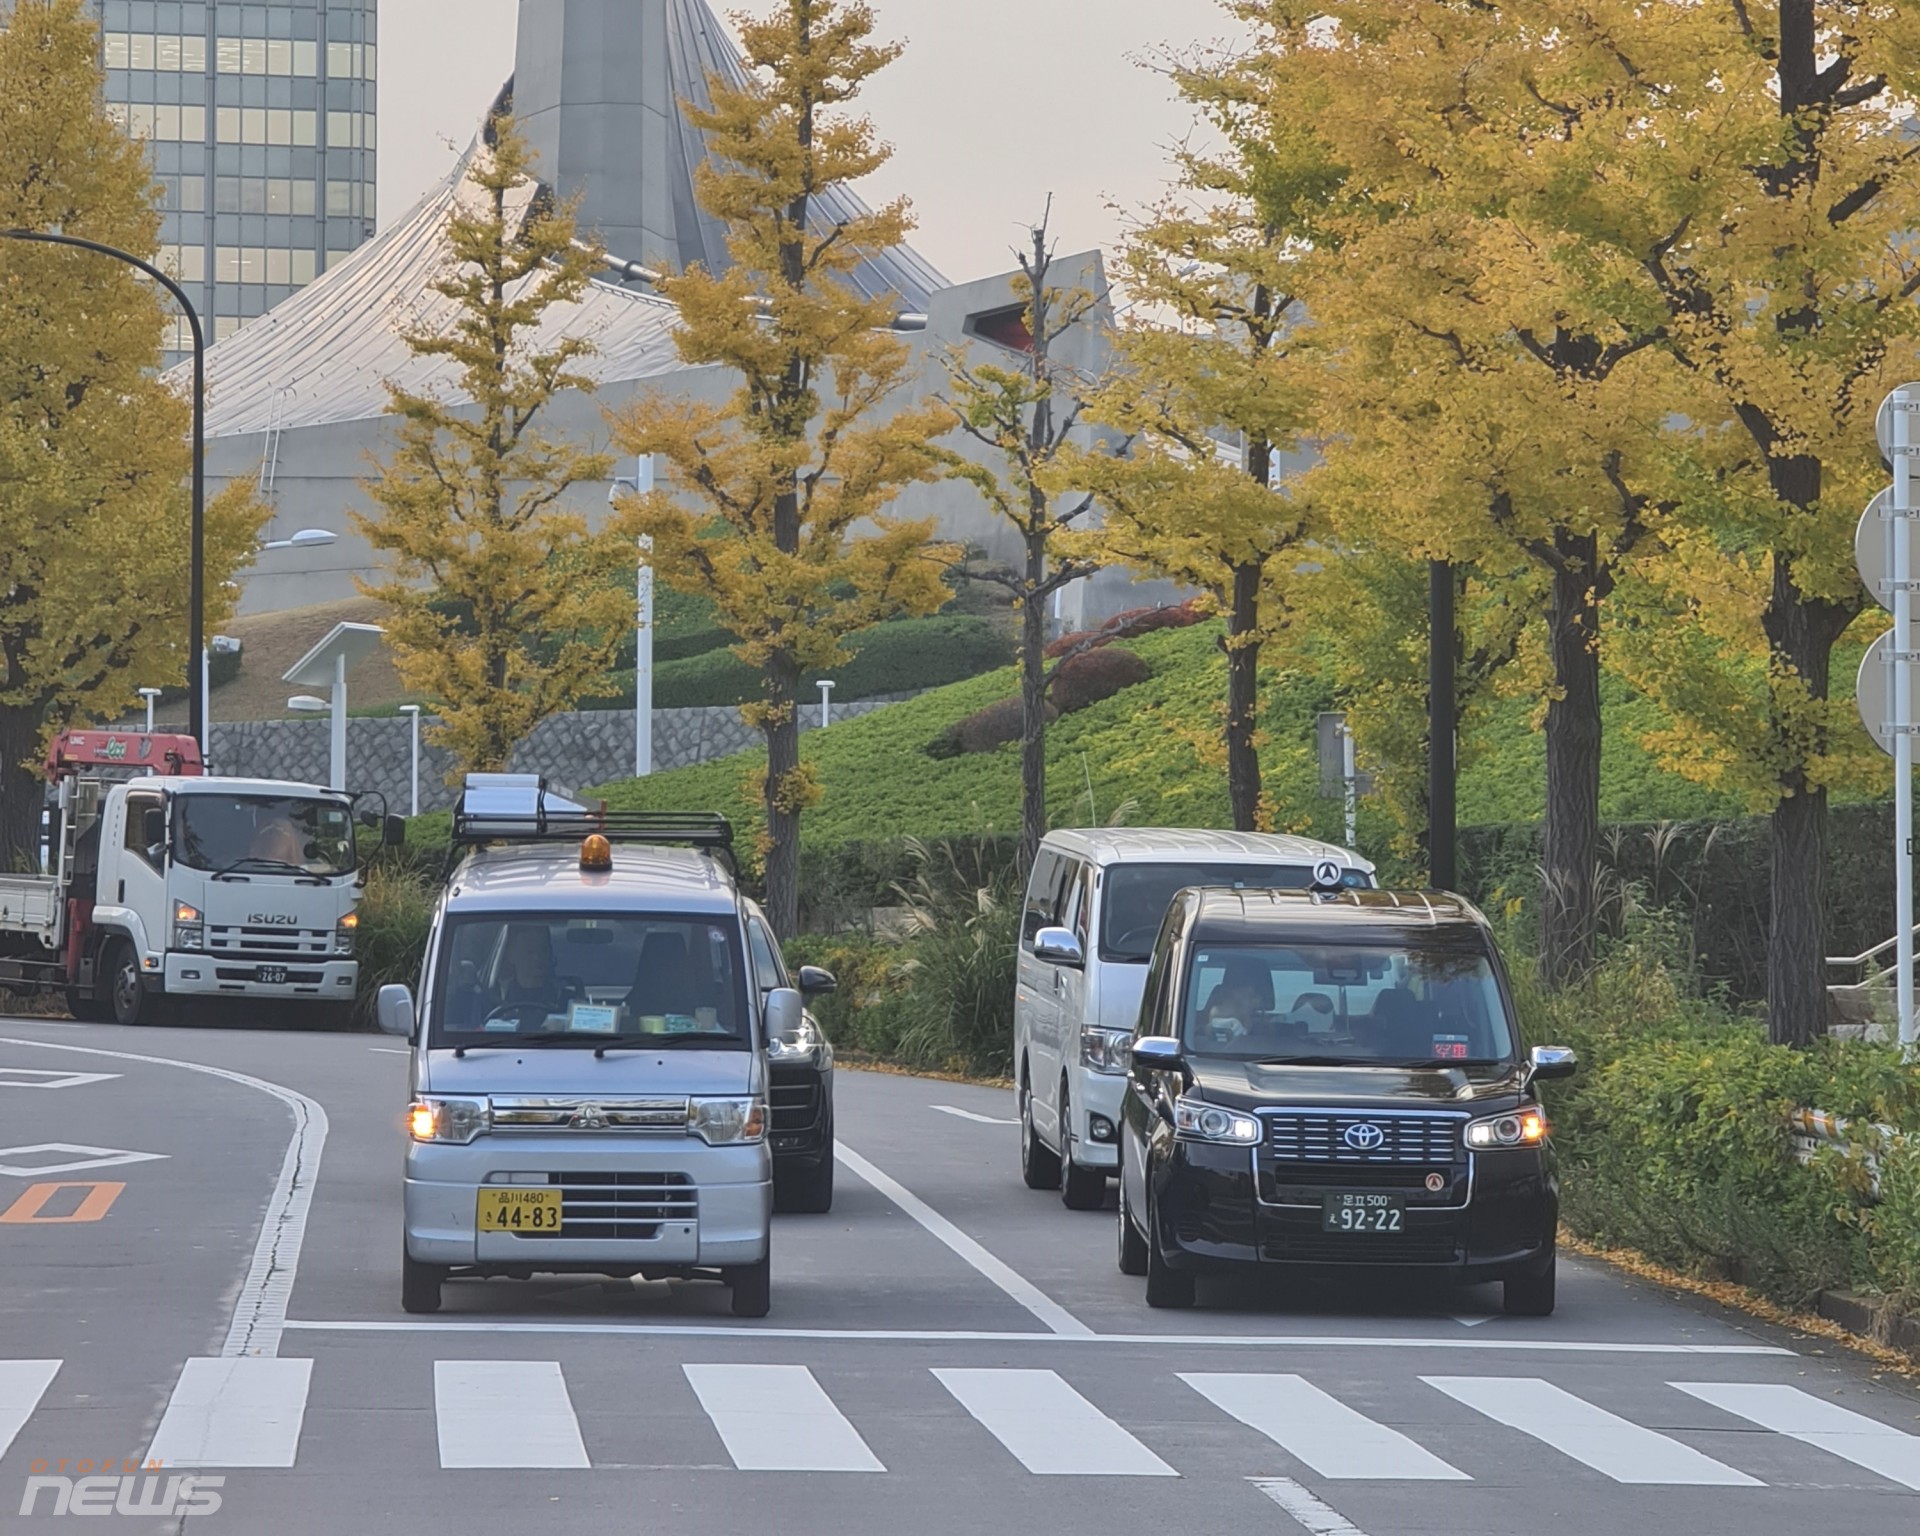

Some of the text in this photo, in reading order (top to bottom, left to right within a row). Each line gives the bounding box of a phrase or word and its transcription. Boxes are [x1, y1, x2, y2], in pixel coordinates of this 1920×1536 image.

[248, 913, 298, 925] ISUZU
[262, 972, 286, 983] 26-07
[497, 1206, 557, 1228] 44-83
[1341, 1208, 1400, 1230] 92-22
